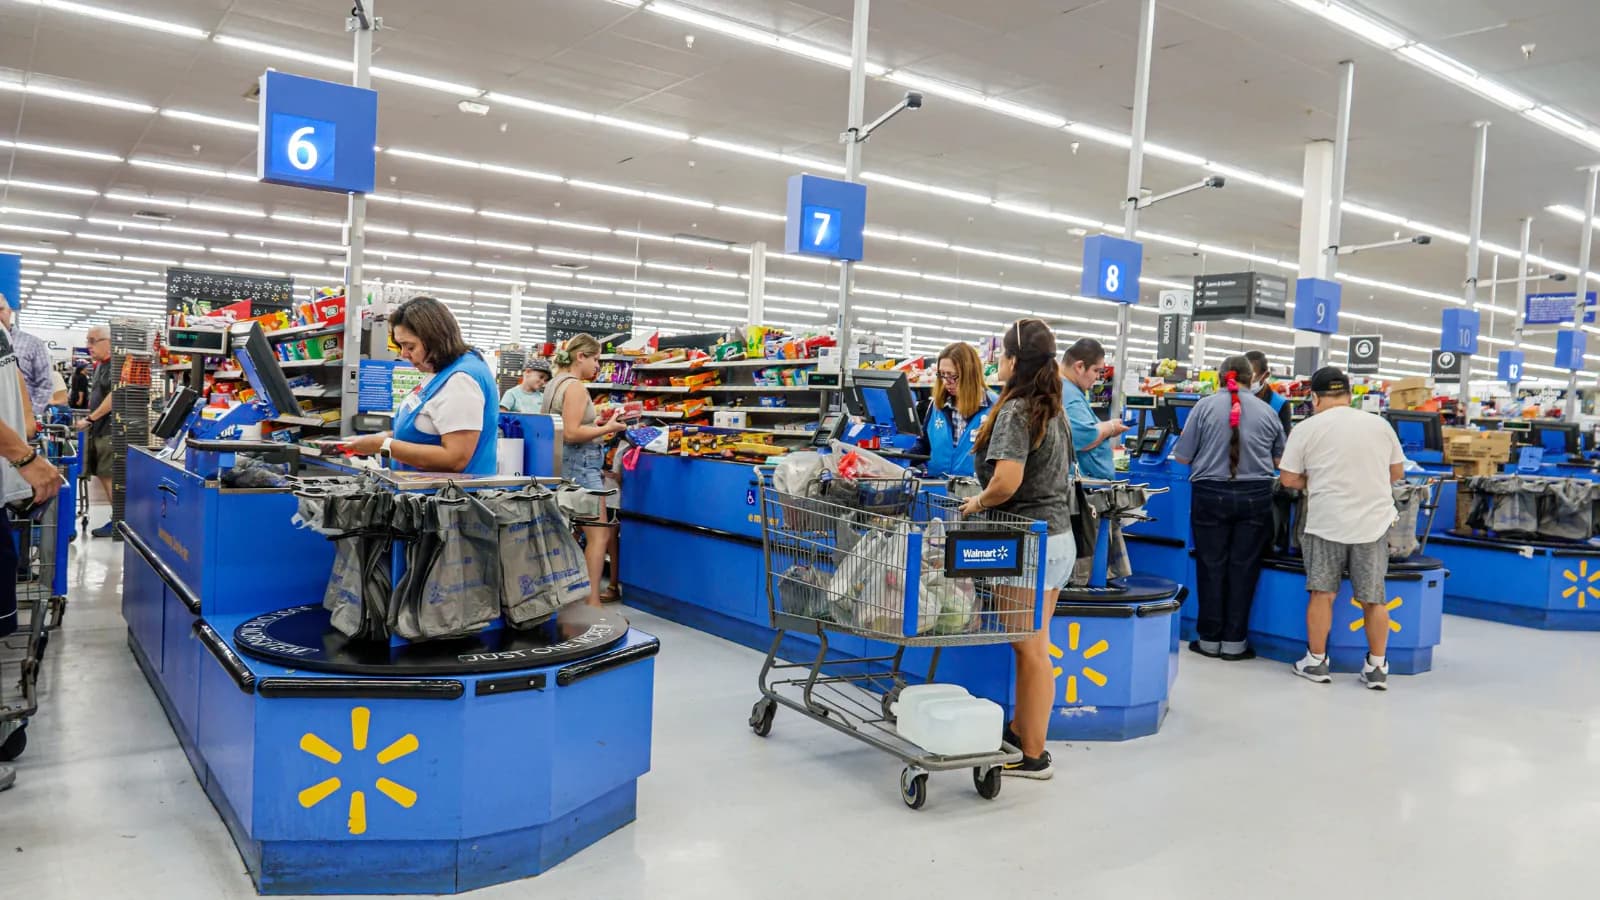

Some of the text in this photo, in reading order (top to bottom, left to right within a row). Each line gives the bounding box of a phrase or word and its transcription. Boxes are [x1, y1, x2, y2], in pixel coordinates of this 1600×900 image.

[287, 126, 318, 170] 6
[813, 211, 831, 245] 7
[1105, 265, 1120, 292] 8
[1316, 302, 1325, 324] 9
[1163, 316, 1171, 344] Home
[1459, 328, 1471, 348] 10
[1509, 364, 1519, 379] 12
[963, 548, 997, 558] Walmart
[466, 650, 527, 662] JUST
[531, 640, 581, 654] ONE
